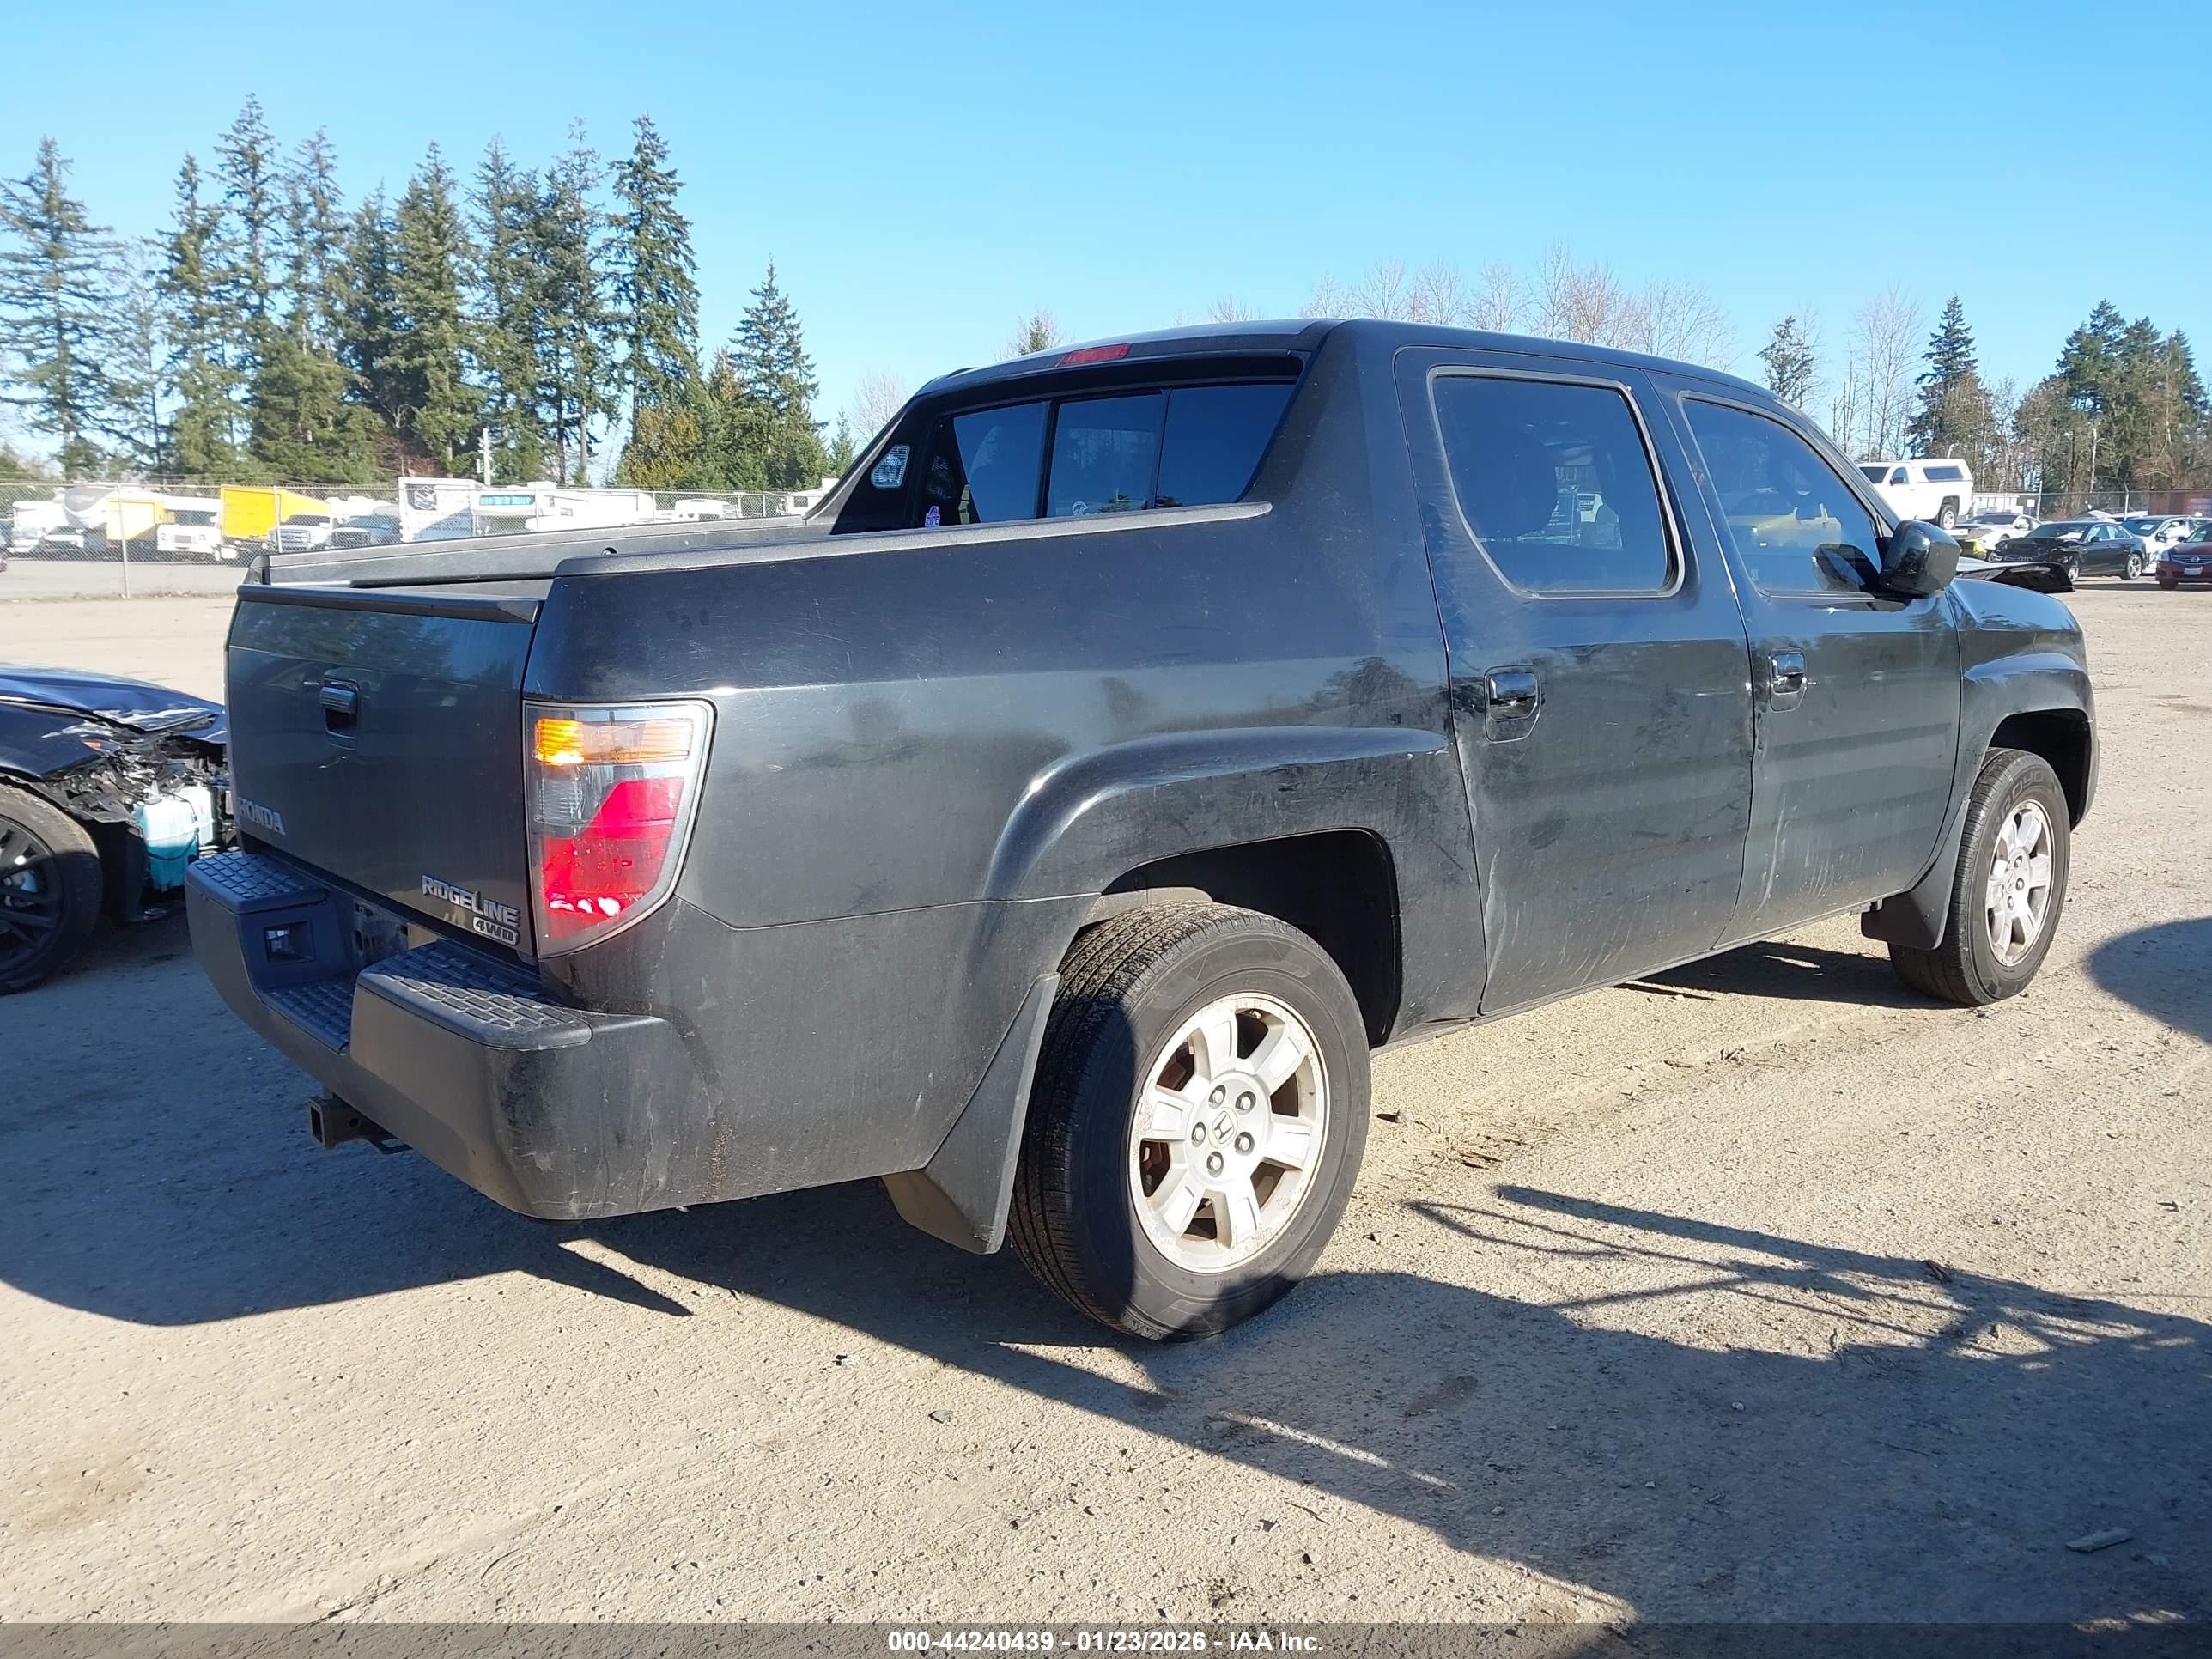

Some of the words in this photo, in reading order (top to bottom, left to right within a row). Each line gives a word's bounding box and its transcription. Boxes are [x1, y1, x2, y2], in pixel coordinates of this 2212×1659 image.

[238, 796, 286, 836] HONDA
[422, 874, 520, 927] RIDGELINE
[475, 920, 514, 942] 4WD
